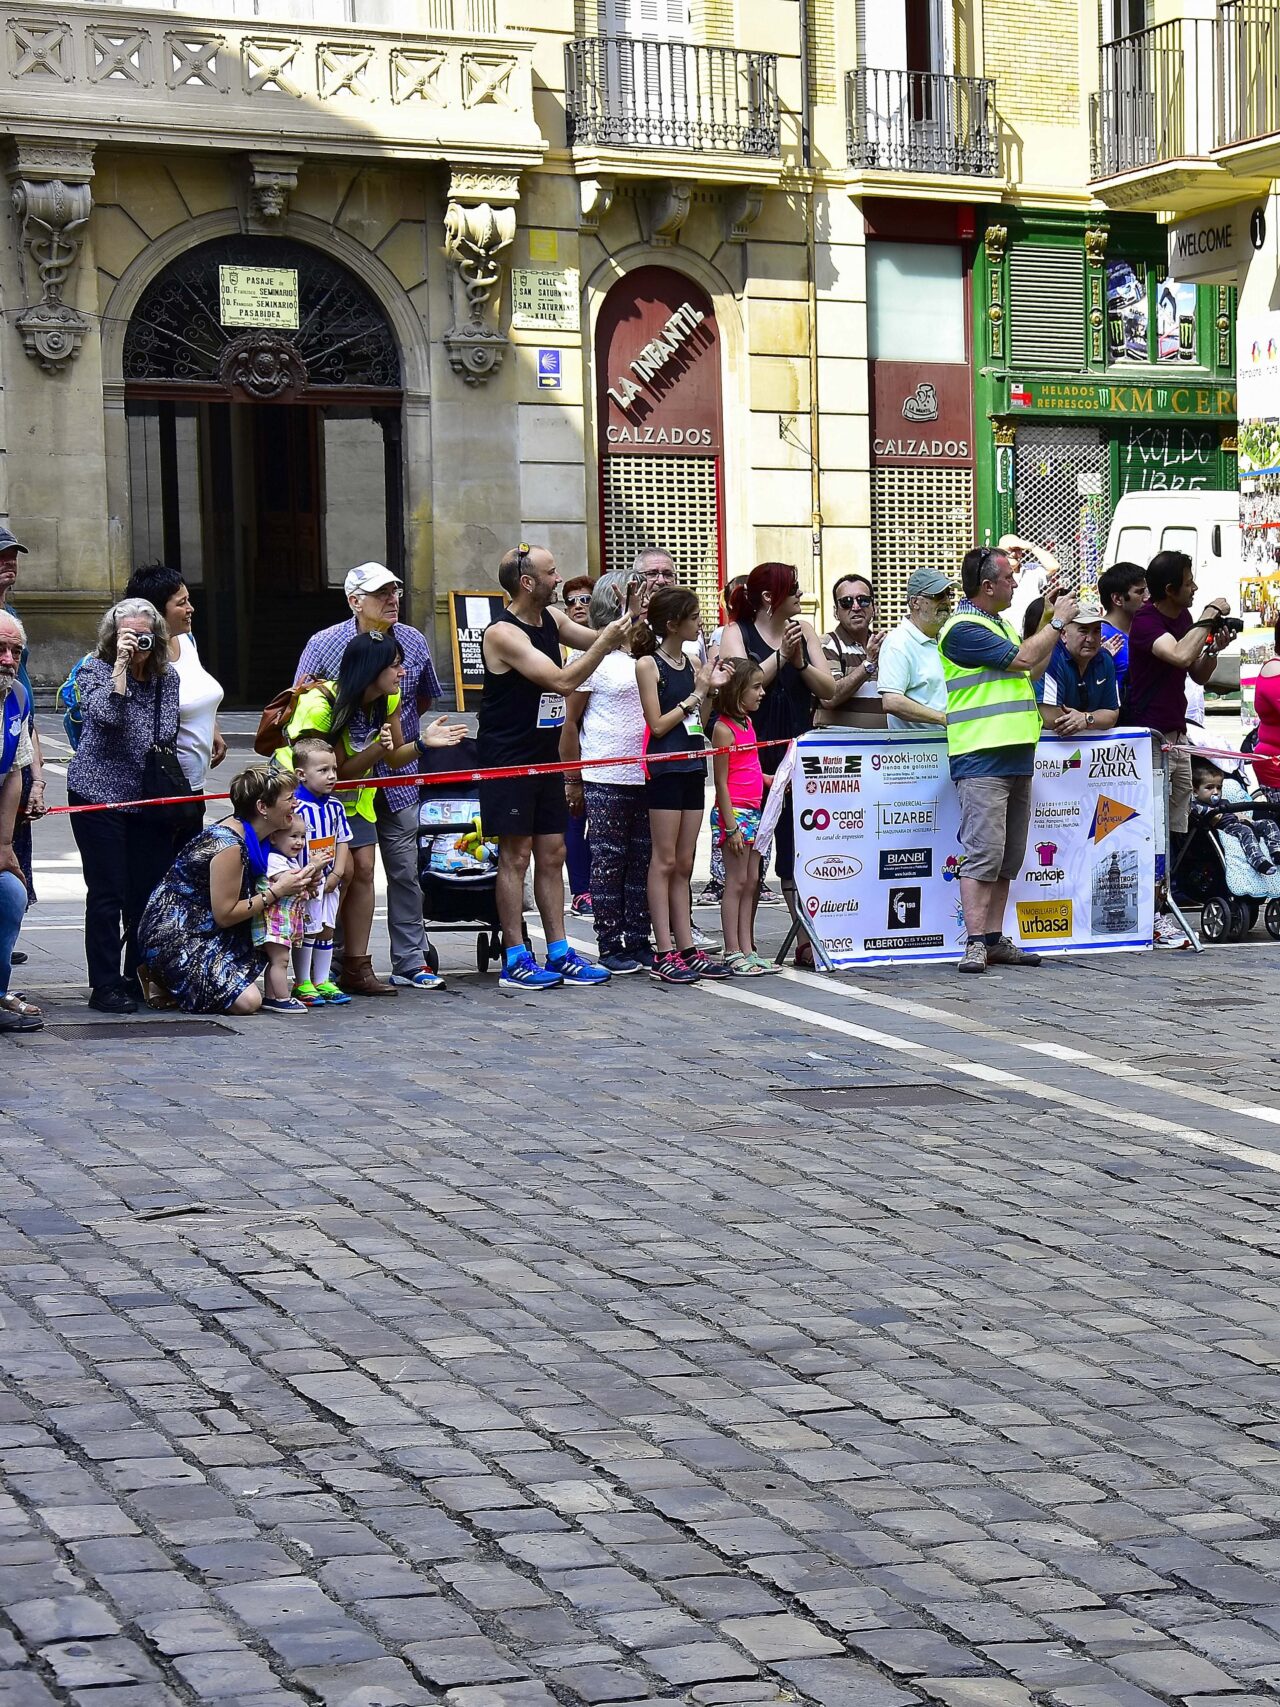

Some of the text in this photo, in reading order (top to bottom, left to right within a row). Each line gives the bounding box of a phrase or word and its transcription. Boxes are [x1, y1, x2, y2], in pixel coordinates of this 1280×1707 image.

[1177, 224, 1232, 258] WELCOME
[246, 277, 275, 286] PASAJE
[538, 278, 557, 286] CALLE
[259, 288, 293, 297] SEMINARIO
[519, 288, 532, 296] SAN
[256, 300, 294, 309] SEMINARIO
[518, 301, 532, 310] SAN
[239, 309, 281, 318] PASABIDEA
[535, 313, 557, 321] KALEA
[629, 302, 705, 383] INFANTIL
[607, 377, 643, 409] LA
[1041, 385, 1095, 396] HELADOS
[1037, 398, 1099, 410] REFRESCOS
[1109, 387, 1237, 415] KM CER
[606, 425, 712, 445] CALZADOS
[873, 439, 968, 457] CALZADOS
[1126, 426, 1212, 467] KOLDO
[457, 628, 485, 642] ME
[1090, 743, 1137, 764] IRUÑA
[871, 752, 938, 770] goxoki-rotxa
[823, 765, 843, 774] Motos
[1088, 761, 1141, 780] ZARRA
[820, 780, 861, 794] YAMAHA
[832, 808, 864, 820] canal
[883, 809, 933, 825] LIZARBE
[1034, 806, 1080, 817] bidaurreta
[839, 820, 864, 830] cero
[887, 852, 925, 864] BIANBI
[813, 866, 855, 878] AROMA
[1025, 868, 1065, 884] markaje
[820, 899, 859, 913] divertis
[1022, 916, 1069, 934] urbasa
[866, 937, 904, 949] ALBERTO
